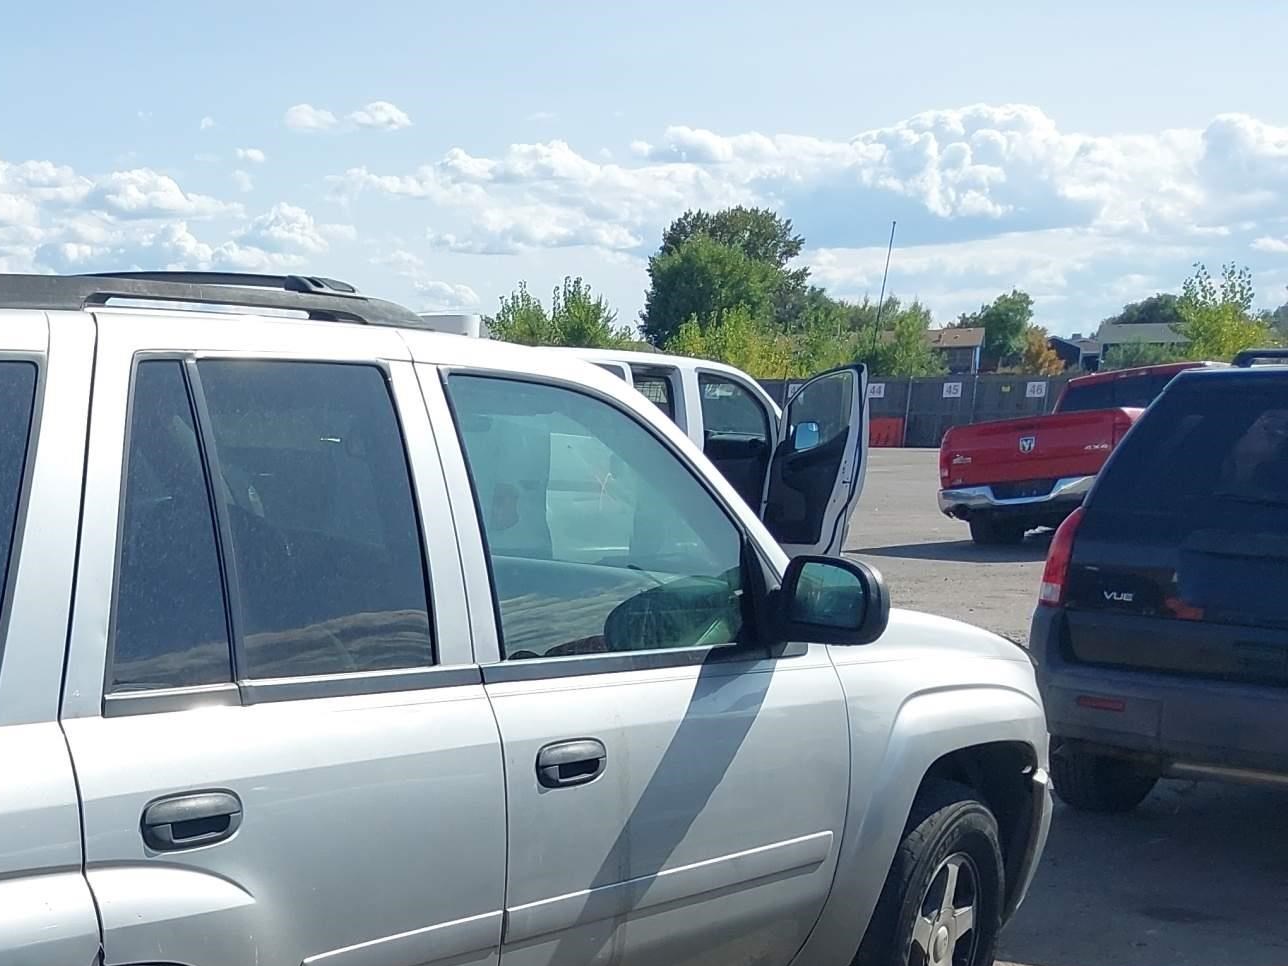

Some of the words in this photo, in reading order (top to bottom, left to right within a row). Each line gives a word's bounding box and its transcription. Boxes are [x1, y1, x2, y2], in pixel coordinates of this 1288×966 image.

[869, 385, 882, 394] 44
[945, 384, 959, 395] 45
[1029, 384, 1043, 395] 46
[1104, 591, 1133, 601] VUE
